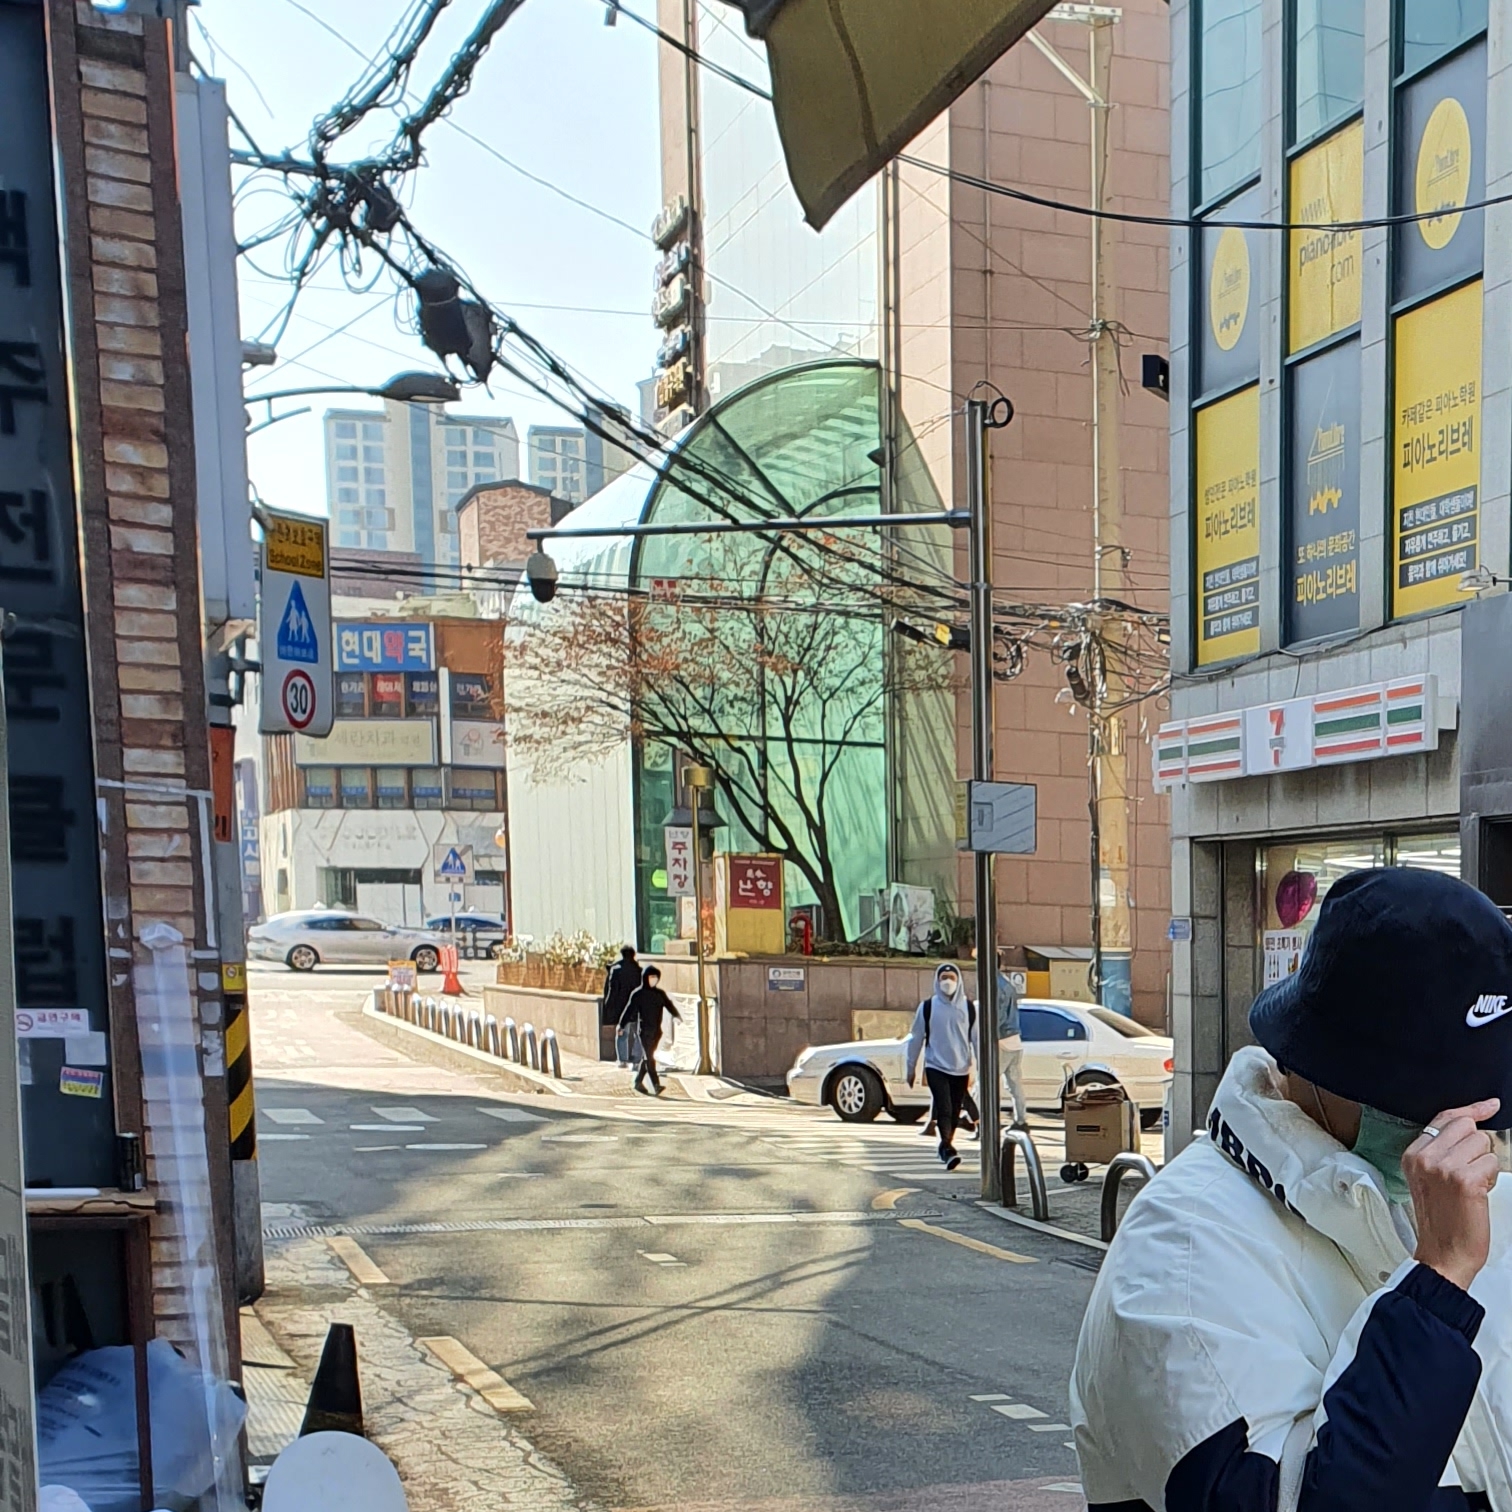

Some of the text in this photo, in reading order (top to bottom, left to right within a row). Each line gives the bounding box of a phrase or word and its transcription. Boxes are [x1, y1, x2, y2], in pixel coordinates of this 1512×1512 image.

[1401, 381, 1476, 429] 카페같은 피아노학원
[1402, 414, 1473, 473] 피아노리브레
[1204, 496, 1256, 543] 피아노리브레
[1296, 559, 1356, 607] 피아노리브레
[340, 629, 428, 665] 현대약국
[290, 682, 308, 715] 30
[1474, 994, 1508, 1014] NIKE
